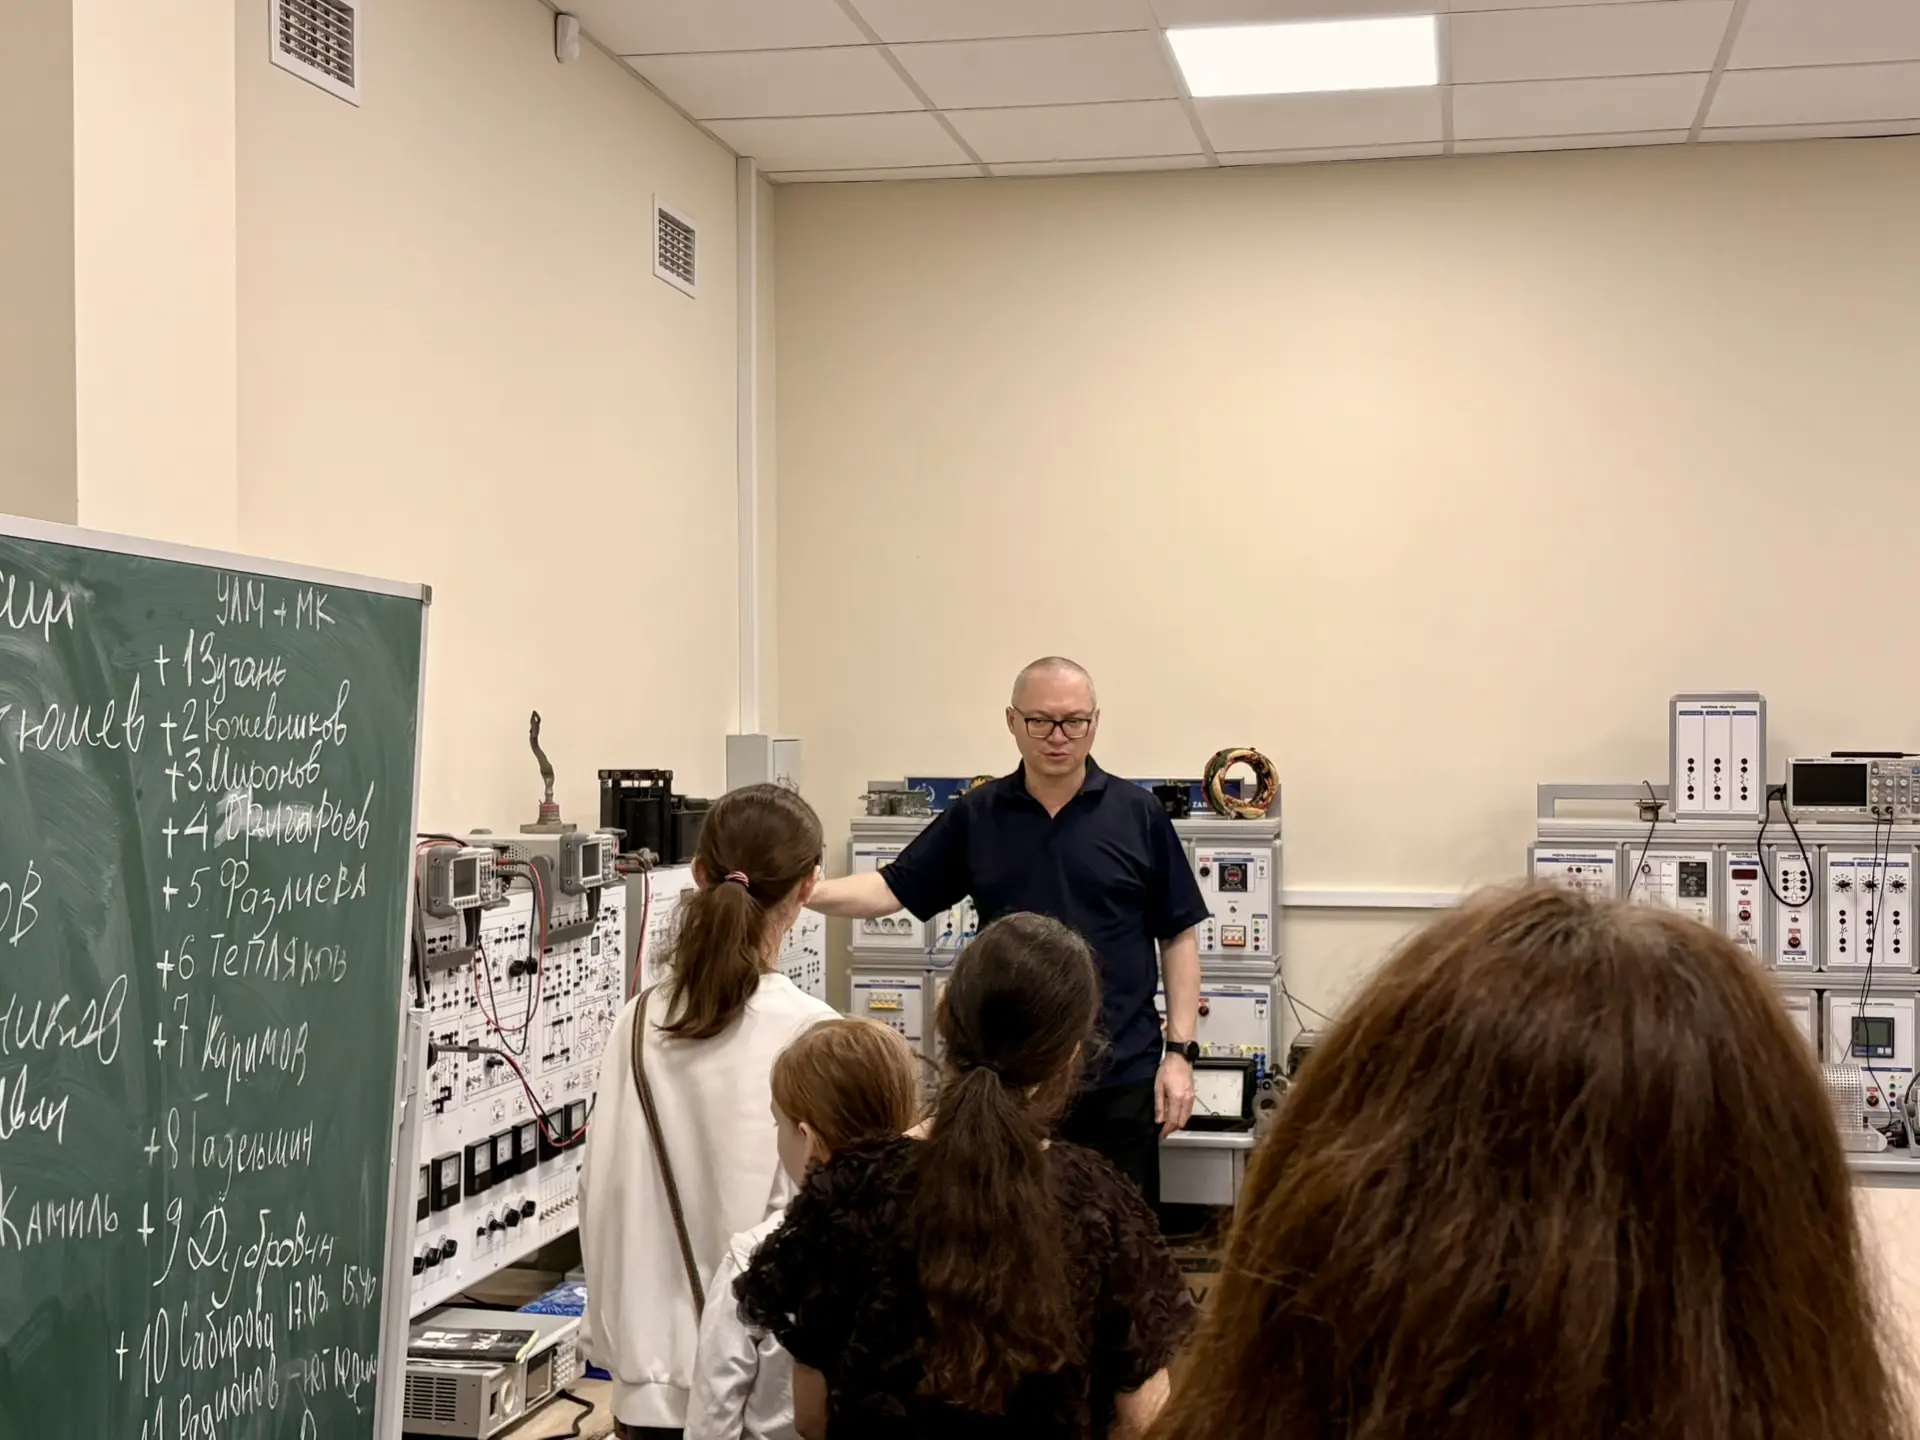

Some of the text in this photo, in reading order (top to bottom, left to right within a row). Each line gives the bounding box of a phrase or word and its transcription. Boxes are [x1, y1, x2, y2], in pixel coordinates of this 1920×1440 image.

[296, 586, 336, 632] МК
[205, 679, 350, 746] Кожевников
[206, 739, 323, 793] Миронов
[184, 800, 208, 852] 4
[187, 867, 211, 908] 5
[179, 934, 195, 980] 6
[174, 993, 189, 1069] 7
[167, 1107, 180, 1169] 8
[139, 1308, 169, 1398] 10
[180, 1300, 274, 1379] Сабирова
